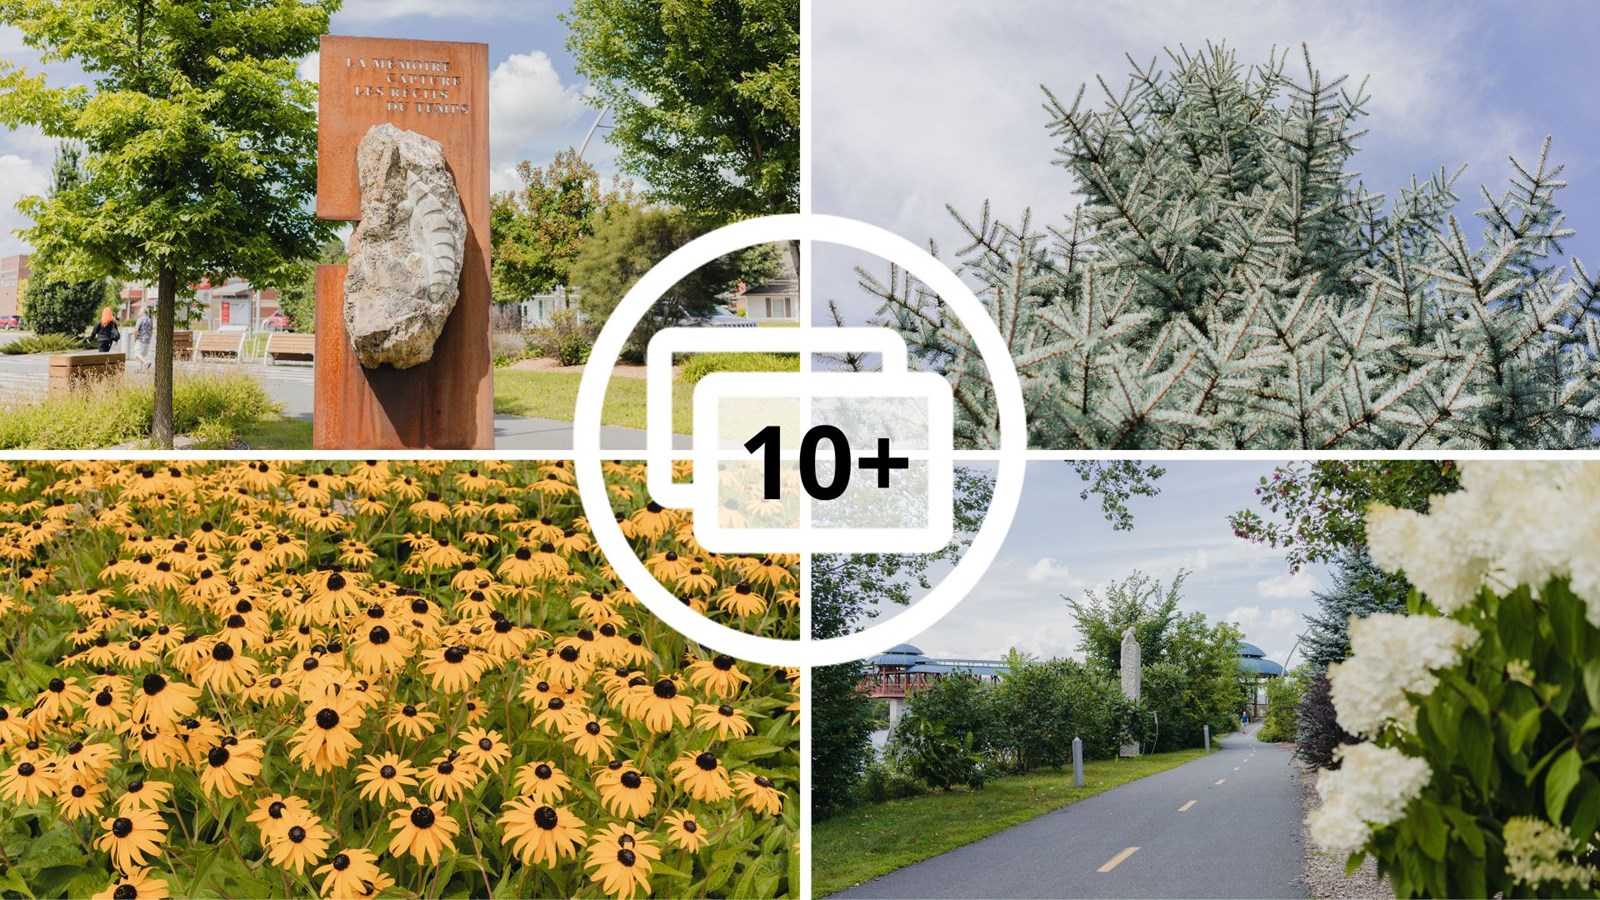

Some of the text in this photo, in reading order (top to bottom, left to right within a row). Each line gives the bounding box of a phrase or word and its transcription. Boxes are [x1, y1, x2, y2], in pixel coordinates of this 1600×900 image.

[346, 57, 451, 72] LA MÉMOIRE
[386, 73, 461, 86] CAPTURE
[354, 86, 449, 99] LES RÉCITS
[386, 100, 469, 114] DU TEMPS
